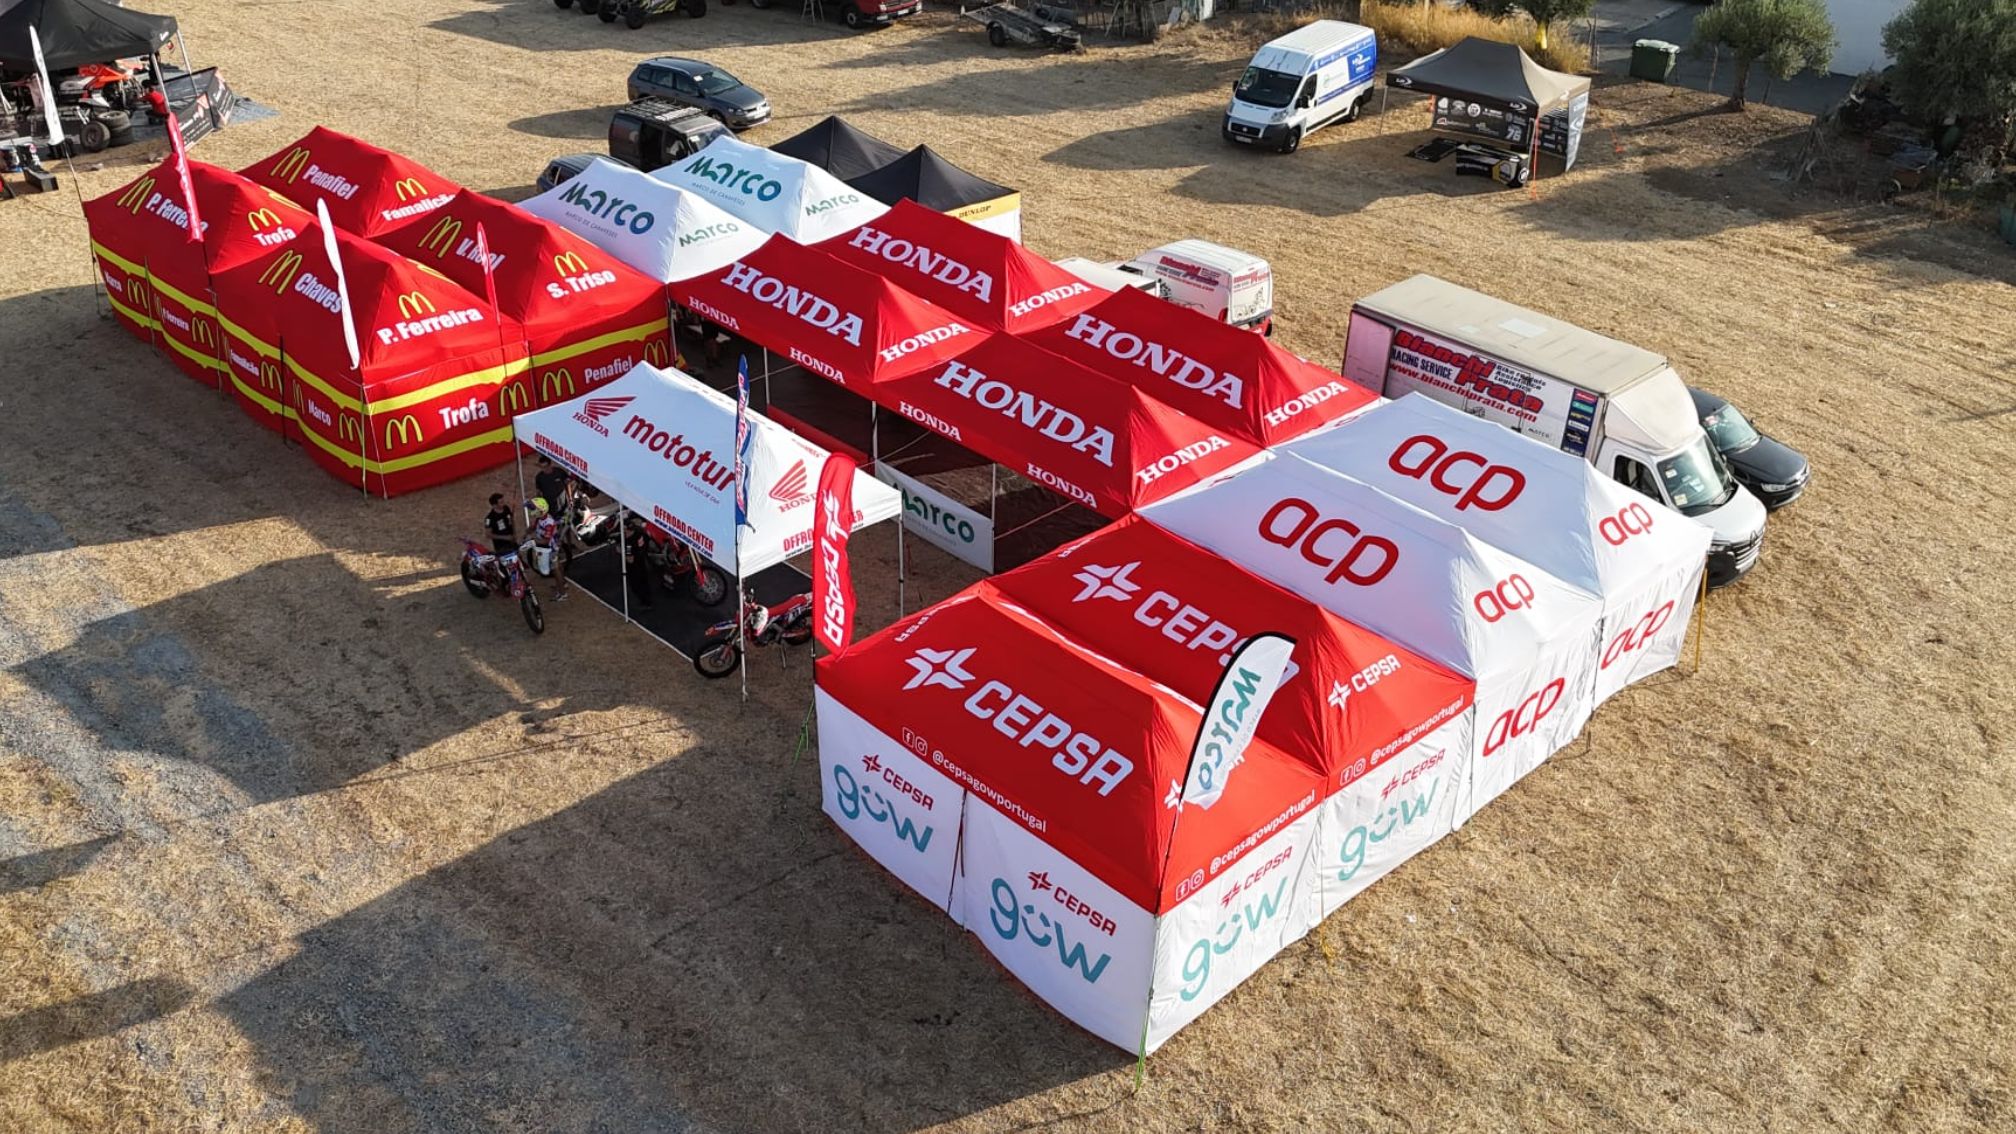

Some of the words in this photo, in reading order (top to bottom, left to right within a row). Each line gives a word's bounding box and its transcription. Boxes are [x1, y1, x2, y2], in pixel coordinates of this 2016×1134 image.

[145, 193, 162, 212] P.
[303, 164, 360, 200] Penafiel
[959, 205, 991, 217] DUNLOP
[253, 226, 297, 247] Trofa
[546, 281, 569, 300] S.
[566, 269, 617, 294] Triso
[849, 226, 996, 303] HONDA
[294, 272, 343, 315] Chaves
[689, 296, 740, 330] HONDA
[720, 261, 866, 347] HONDA
[1008, 282, 1091, 317] HONDA
[377, 328, 399, 346] P.
[399, 309, 484, 339] Ferreira
[880, 321, 971, 364] HONDA
[585, 357, 633, 383] Penafiel
[790, 346, 846, 384] HONDA
[1064, 314, 1244, 409] HONDA
[1391, 347, 1419, 367] RACING
[1420, 358, 1453, 380] SERVICE
[1393, 329, 1496, 378] Bianchi
[308, 400, 331, 426] Marco
[933, 360, 1118, 467] HONDA
[1264, 381, 1348, 428] HONDA
[1389, 361, 1537, 423] www.bianchiprata.com
[1454, 370, 1544, 414] Prata
[439, 399, 489, 430] Trofa
[573, 412, 609, 438] HONDA
[899, 401, 962, 441] HONDA
[535, 432, 565, 458] OFFROAD
[564, 446, 588, 473] CENTER
[623, 415, 735, 491] mototur
[1136, 434, 1232, 485] HONDA
[1388, 434, 1526, 512] acp
[778, 493, 819, 512] HOND
[1027, 463, 1097, 509] HONDA
[654, 505, 687, 532] OFFROAD
[686, 521, 714, 550] CENTER
[1258, 498, 1399, 586] acp
[1599, 502, 1654, 546] acp
[821, 537, 845, 647] CEPSA
[1474, 573, 1534, 623] acp
[1600, 600, 1674, 671] acp
[1352, 654, 1401, 693] CEPSA
[964, 680, 1134, 797] CEPSA
[1370, 695, 1464, 764] @cepsagowportugal
[1483, 677, 1565, 757] acp
[884, 768, 934, 811] CEPSA
[1401, 749, 1446, 786] CEPSA
[932, 750, 1046, 833] @cepsagowportugal
[1210, 790, 1315, 874] @cepsagowportugal
[1244, 846, 1293, 891] CEPSA
[1054, 886, 1117, 936] CEPSA
